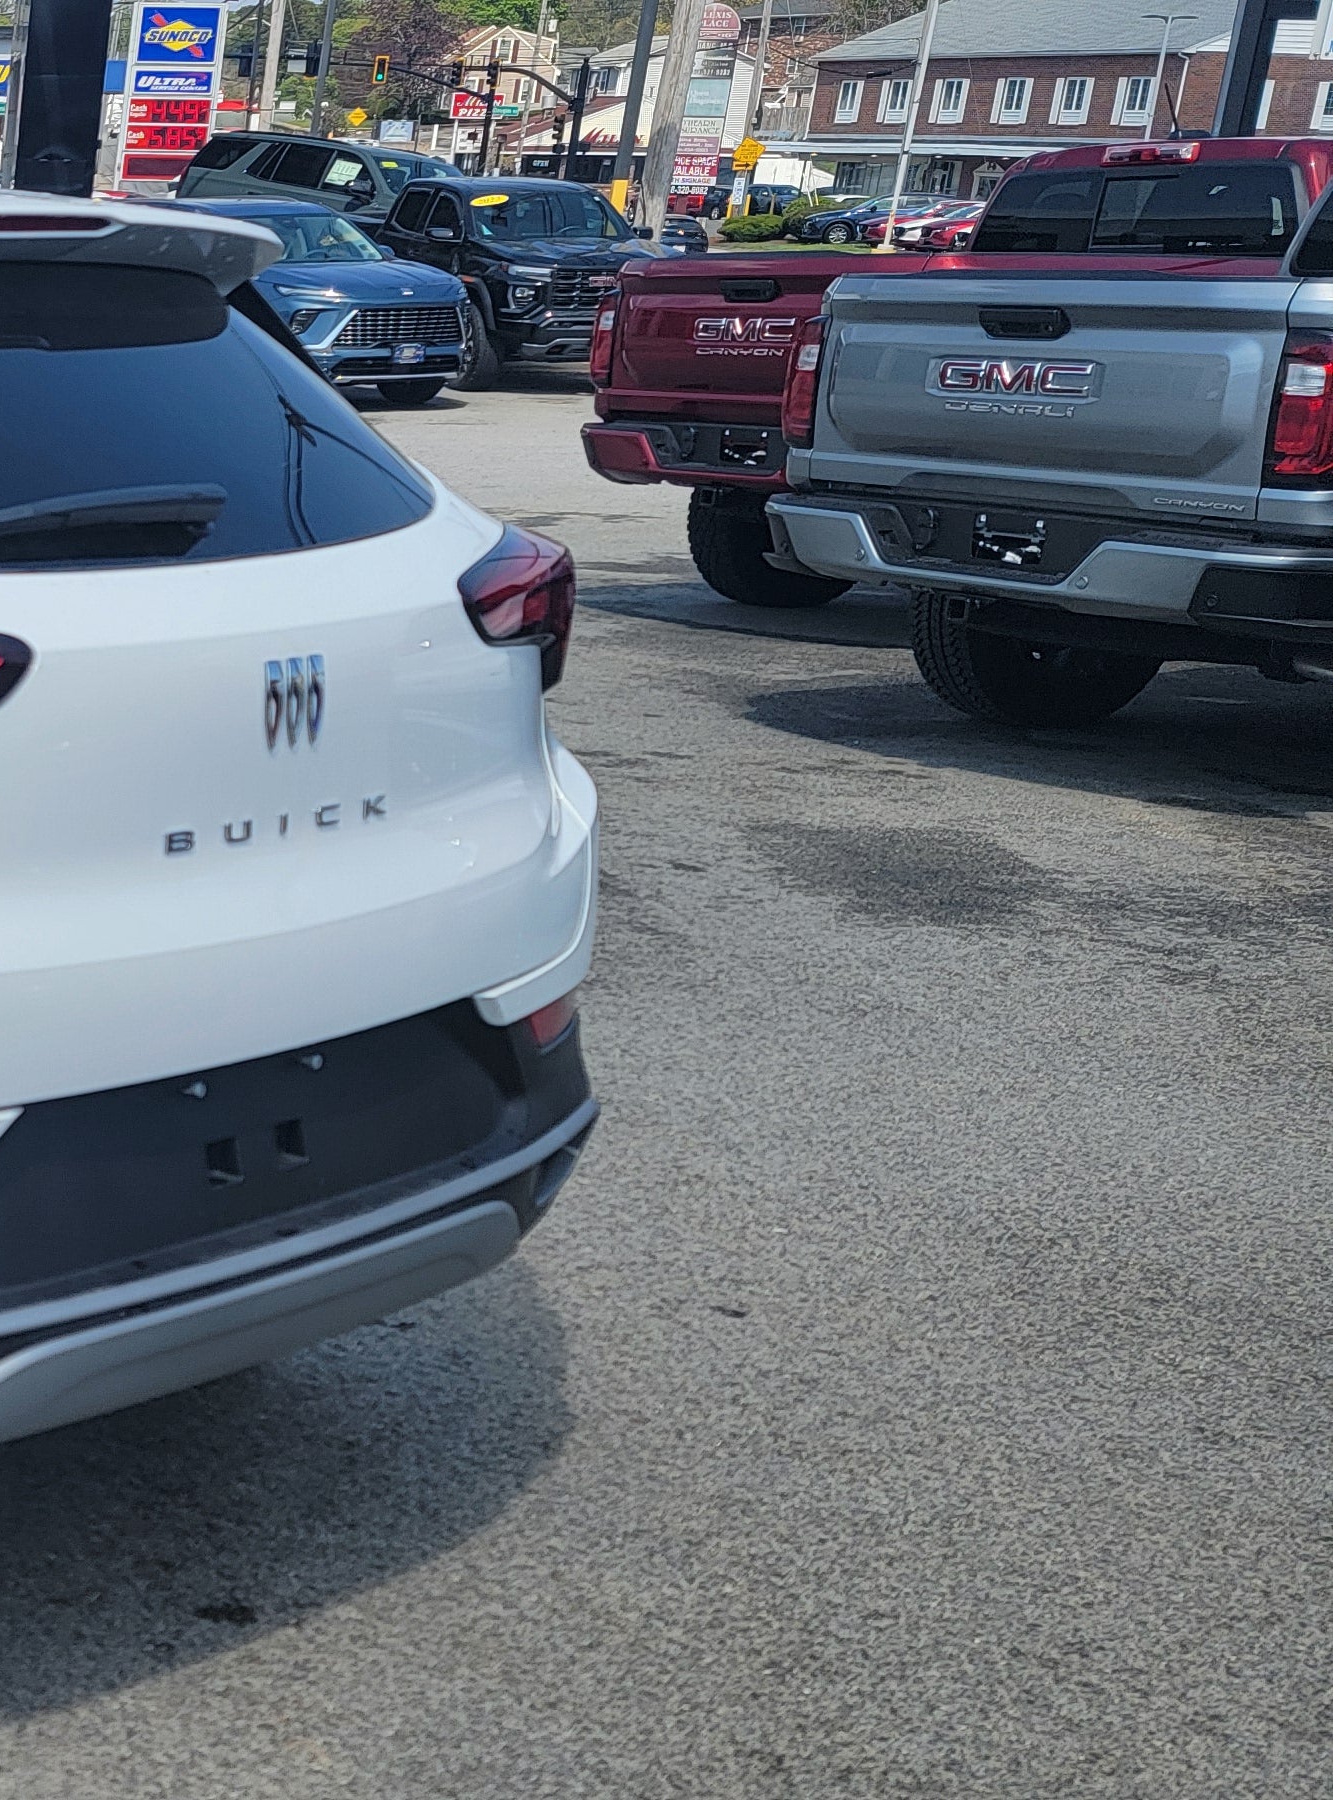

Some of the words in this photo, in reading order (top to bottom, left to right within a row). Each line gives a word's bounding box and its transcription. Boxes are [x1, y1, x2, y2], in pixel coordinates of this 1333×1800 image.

[703, 11, 732, 19] LEXIS
[148, 30, 210, 42] SUNOCO
[137, 75, 197, 87] ULTRA
[130, 104, 147, 112] Cash
[458, 108, 488, 117] PIZZ
[127, 131, 145, 139] Cash
[681, 127, 721, 135] SURANCE
[673, 166, 711, 176] VAILABLE
[589, 276, 618, 288] GM
[693, 317, 796, 342] GMC
[695, 347, 785, 357] CANYON
[937, 359, 1096, 397] GMC
[944, 400, 1076, 418] DENALI
[1153, 497, 1246, 512] CANYON
[164, 795, 387, 856] BUICK
